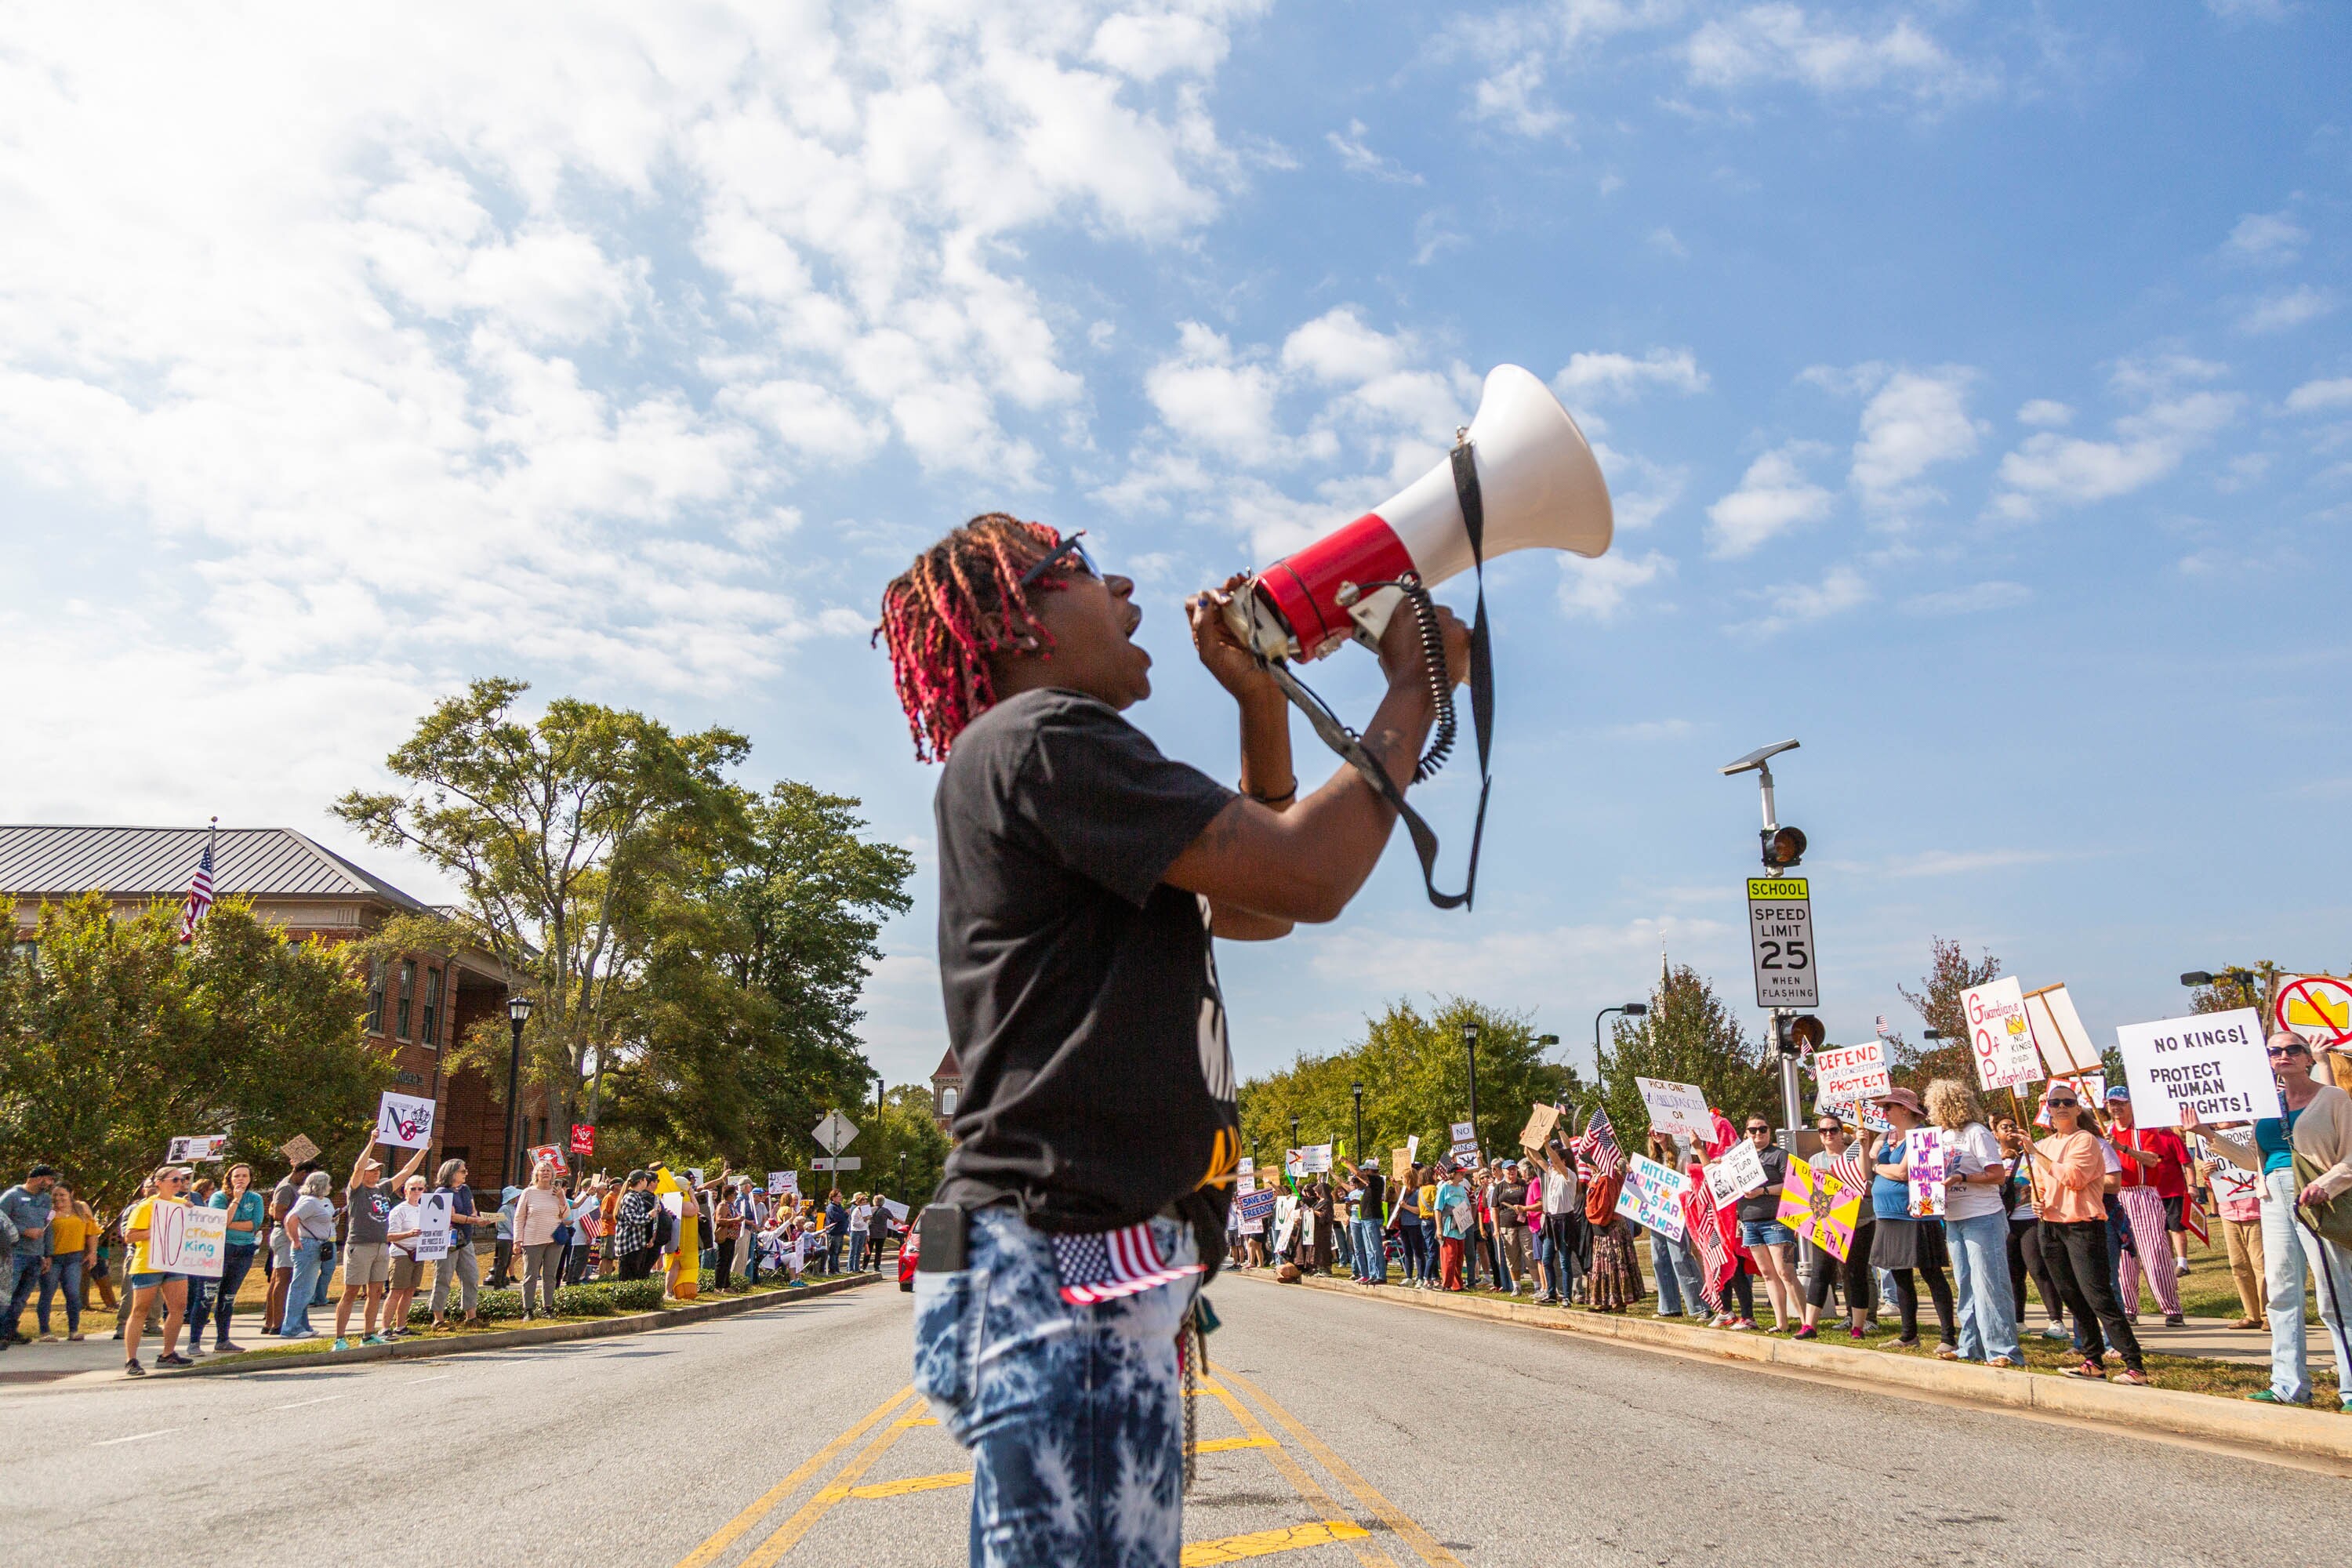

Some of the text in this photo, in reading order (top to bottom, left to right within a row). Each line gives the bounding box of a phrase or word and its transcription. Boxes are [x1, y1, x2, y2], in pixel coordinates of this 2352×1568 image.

[1752, 884, 1806, 895] SCHOOL
[1755, 909, 1806, 920] SPEED
[1762, 925, 1801, 937] LIMIT
[1760, 942, 1808, 970] 25
[1969, 993, 2020, 1025] Guardians
[2013, 1033, 2024, 1043] NO
[2154, 1025, 2249, 1054] NO KINGS!
[2011, 1040, 2033, 1053] KINGS
[1818, 1046, 1878, 1072] DEFEND
[1823, 1069, 1839, 1081] OUR
[1983, 1058, 2038, 1090] Pedophiles
[2150, 1061, 2221, 1083] PROTECT
[1648, 1080, 1686, 1093] PICK ONE
[1829, 1073, 1886, 1094] PROTECT
[2167, 1078, 2225, 1098] HUMAN
[1672, 1110, 1684, 1120] OR
[1456, 1127, 1470, 1136] NO
[1453, 1142, 1477, 1152] KINGS
[1914, 1133, 1918, 1149] I
[1918, 1149, 1931, 1165] NOT
[1733, 1158, 1751, 1173] TURD
[1910, 1165, 1943, 1181] NORMALIZE
[1640, 1160, 1680, 1189] HITLER
[1737, 1168, 1760, 1188] REICH
[1243, 1192, 1273, 1207] SAVE OUR
[1620, 1192, 1649, 1213] WITH
[1640, 1210, 1681, 1239] CAMPS
[1784, 1211, 1802, 1226] HAS
[151, 1203, 184, 1267] NO
[1810, 1221, 1847, 1254] TEETH!
[184, 1240, 214, 1258] King
